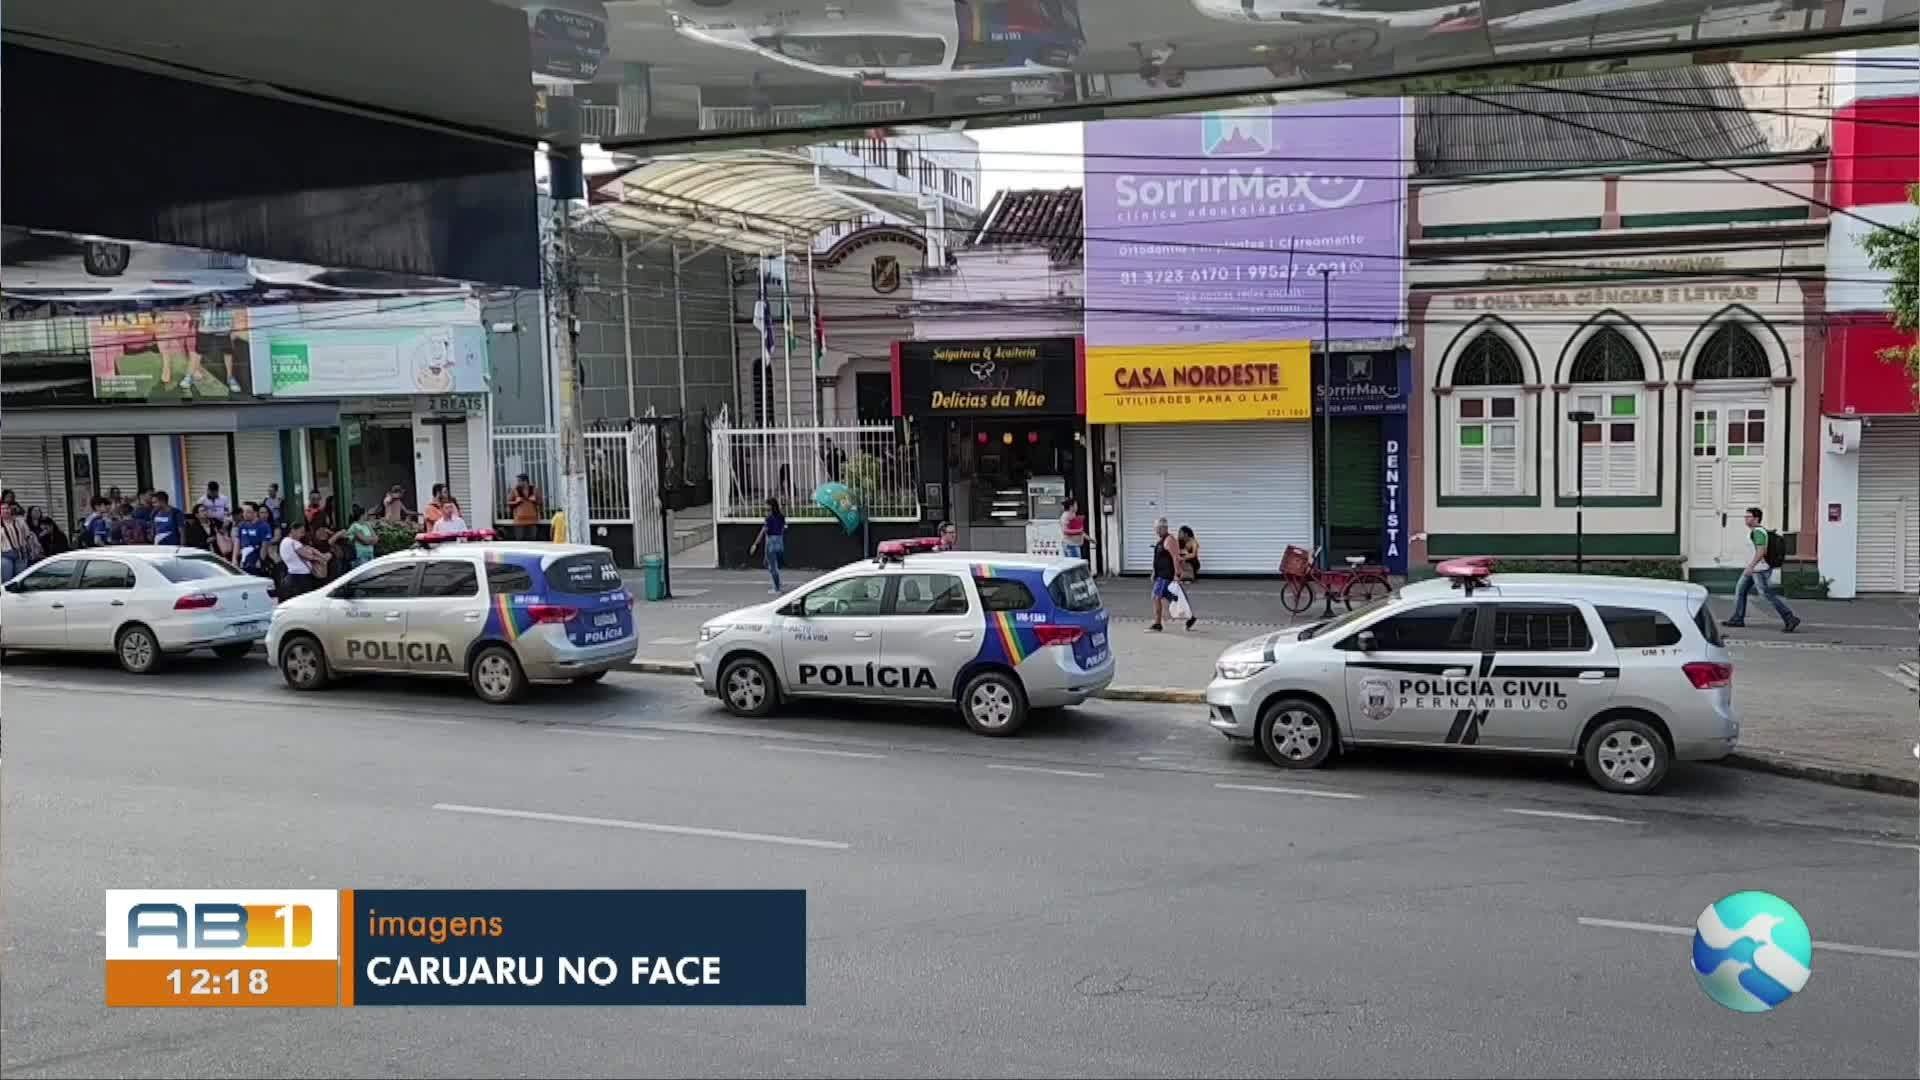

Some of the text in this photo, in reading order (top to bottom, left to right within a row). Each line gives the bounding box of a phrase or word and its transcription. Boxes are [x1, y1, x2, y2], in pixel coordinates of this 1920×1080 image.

[1115, 167, 1314, 207] SorrirMax
[1684, 285, 1758, 301] LETRAS
[1114, 362, 1280, 388] CASA NORDESTE
[991, 391, 1010, 408] da
[1014, 388, 1046, 408] Mãe
[1116, 391, 1280, 407] UTILIDADES PARA O LAR
[1386, 440, 1400, 557] DENTISTA
[584, 627, 623, 643] POLÍCIA
[346, 638, 454, 664] POLÍCIA
[799, 661, 938, 691] POLÍCIA
[1502, 680, 1568, 698] CIVIL
[1399, 697, 1569, 711] PERNAMBUCO
